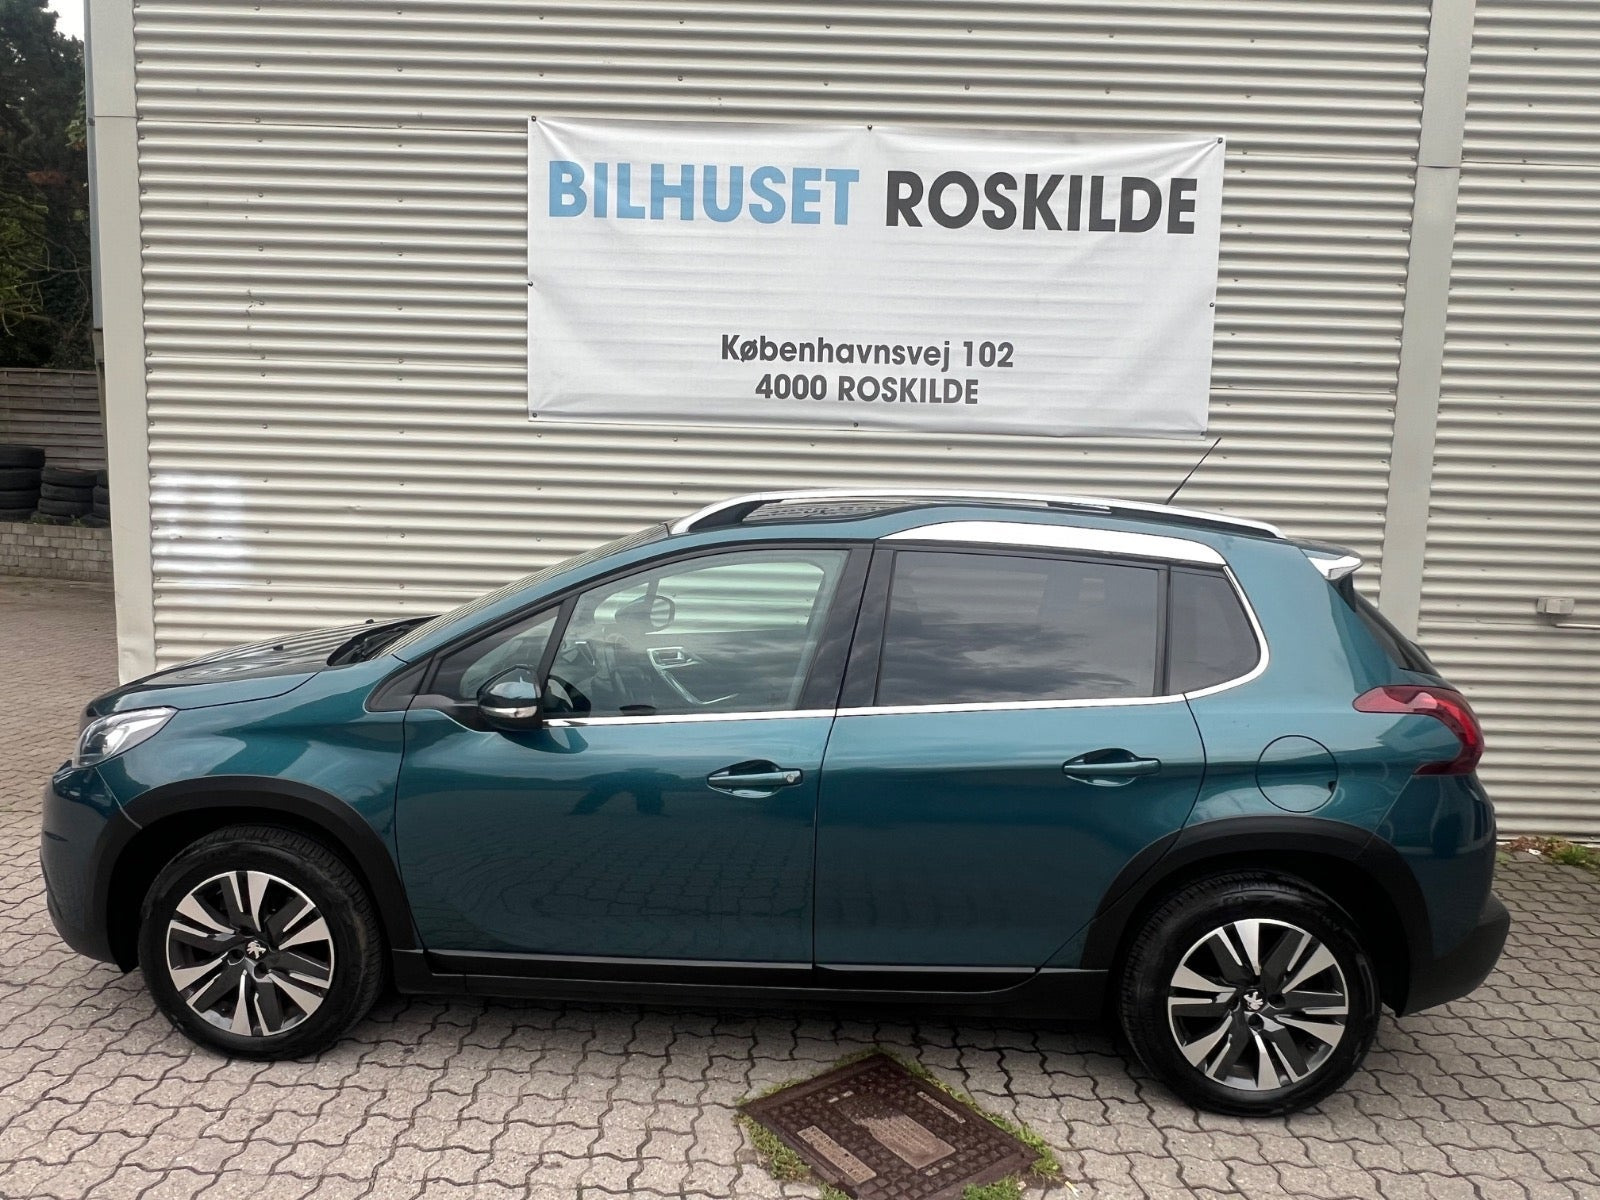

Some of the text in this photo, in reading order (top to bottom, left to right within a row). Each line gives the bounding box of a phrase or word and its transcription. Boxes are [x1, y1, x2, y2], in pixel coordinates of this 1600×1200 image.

[549, 160, 1197, 235] BILHUSET ROSKILDE
[721, 334, 1014, 372] Københavnsvej 102
[755, 374, 979, 405] 4000 ROSKILDE
